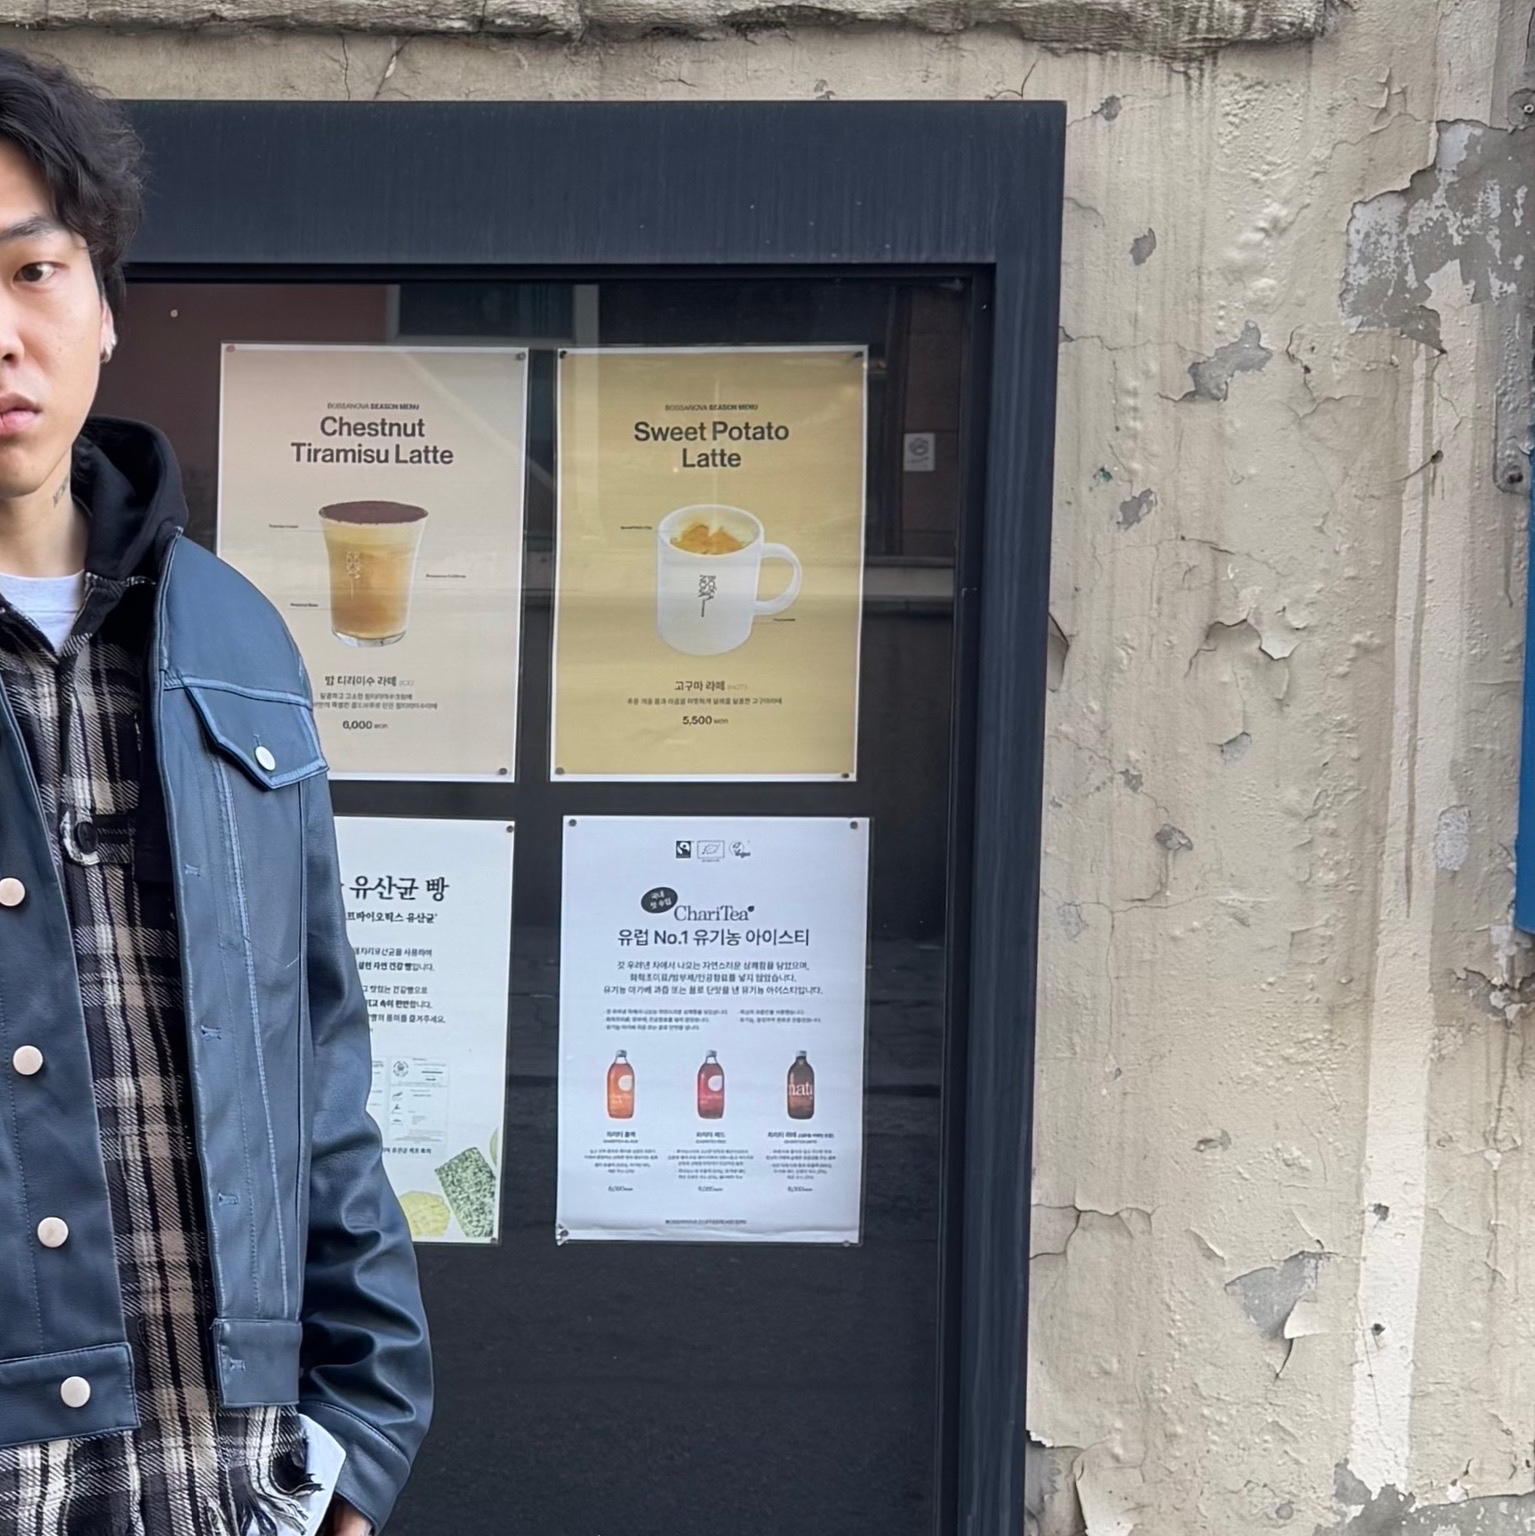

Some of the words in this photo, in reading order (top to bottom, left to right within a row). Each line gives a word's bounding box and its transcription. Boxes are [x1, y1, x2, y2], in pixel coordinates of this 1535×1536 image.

[320, 416, 426, 438] Chestnut
[634, 421, 707, 442] Sweet
[712, 421, 790, 441] Potato
[290, 442, 389, 464] Tiramisu
[395, 444, 454, 465] Latte
[682, 448, 742, 468] Latte
[674, 680, 703, 692] 고구마
[342, 720, 373, 730] 6,000
[682, 715, 713, 726] 5,500
[349, 875, 419, 901] 유산균
[426, 877, 450, 902] 빵
[673, 905, 749, 922] ChariTea
[617, 929, 649, 946] 유럽
[653, 930, 688, 945] No.1
[693, 928, 742, 946] 유기농
[745, 929, 809, 946] 아이스티
